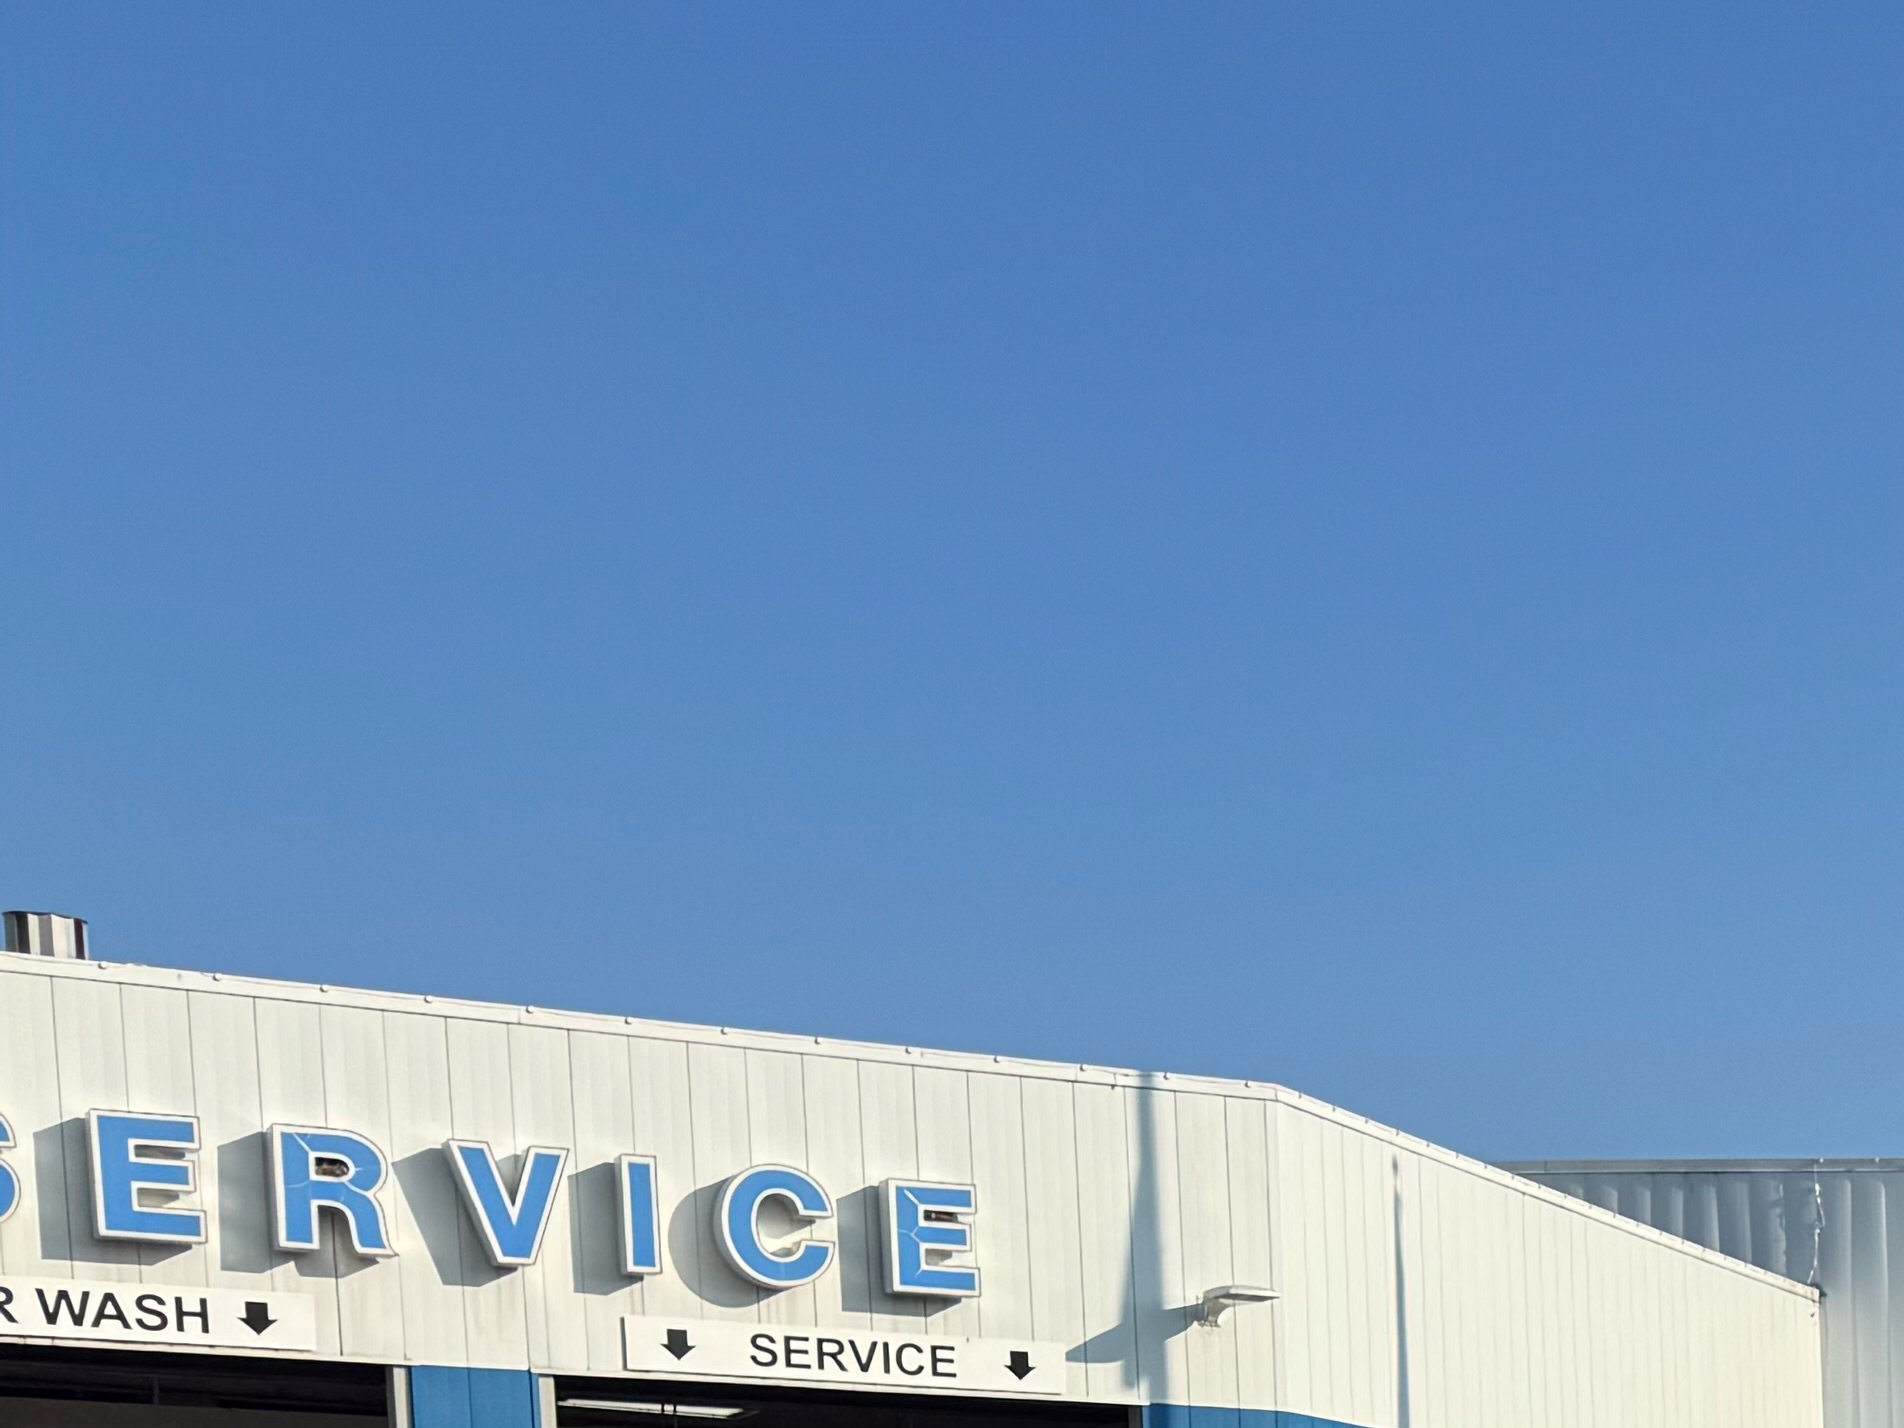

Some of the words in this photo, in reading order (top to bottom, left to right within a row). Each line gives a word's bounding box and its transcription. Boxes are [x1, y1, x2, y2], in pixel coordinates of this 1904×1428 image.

[0, 1108, 981, 1298] ERVICE
[35, 1287, 210, 1334] WASH
[750, 1333, 957, 1378] SERVICE
